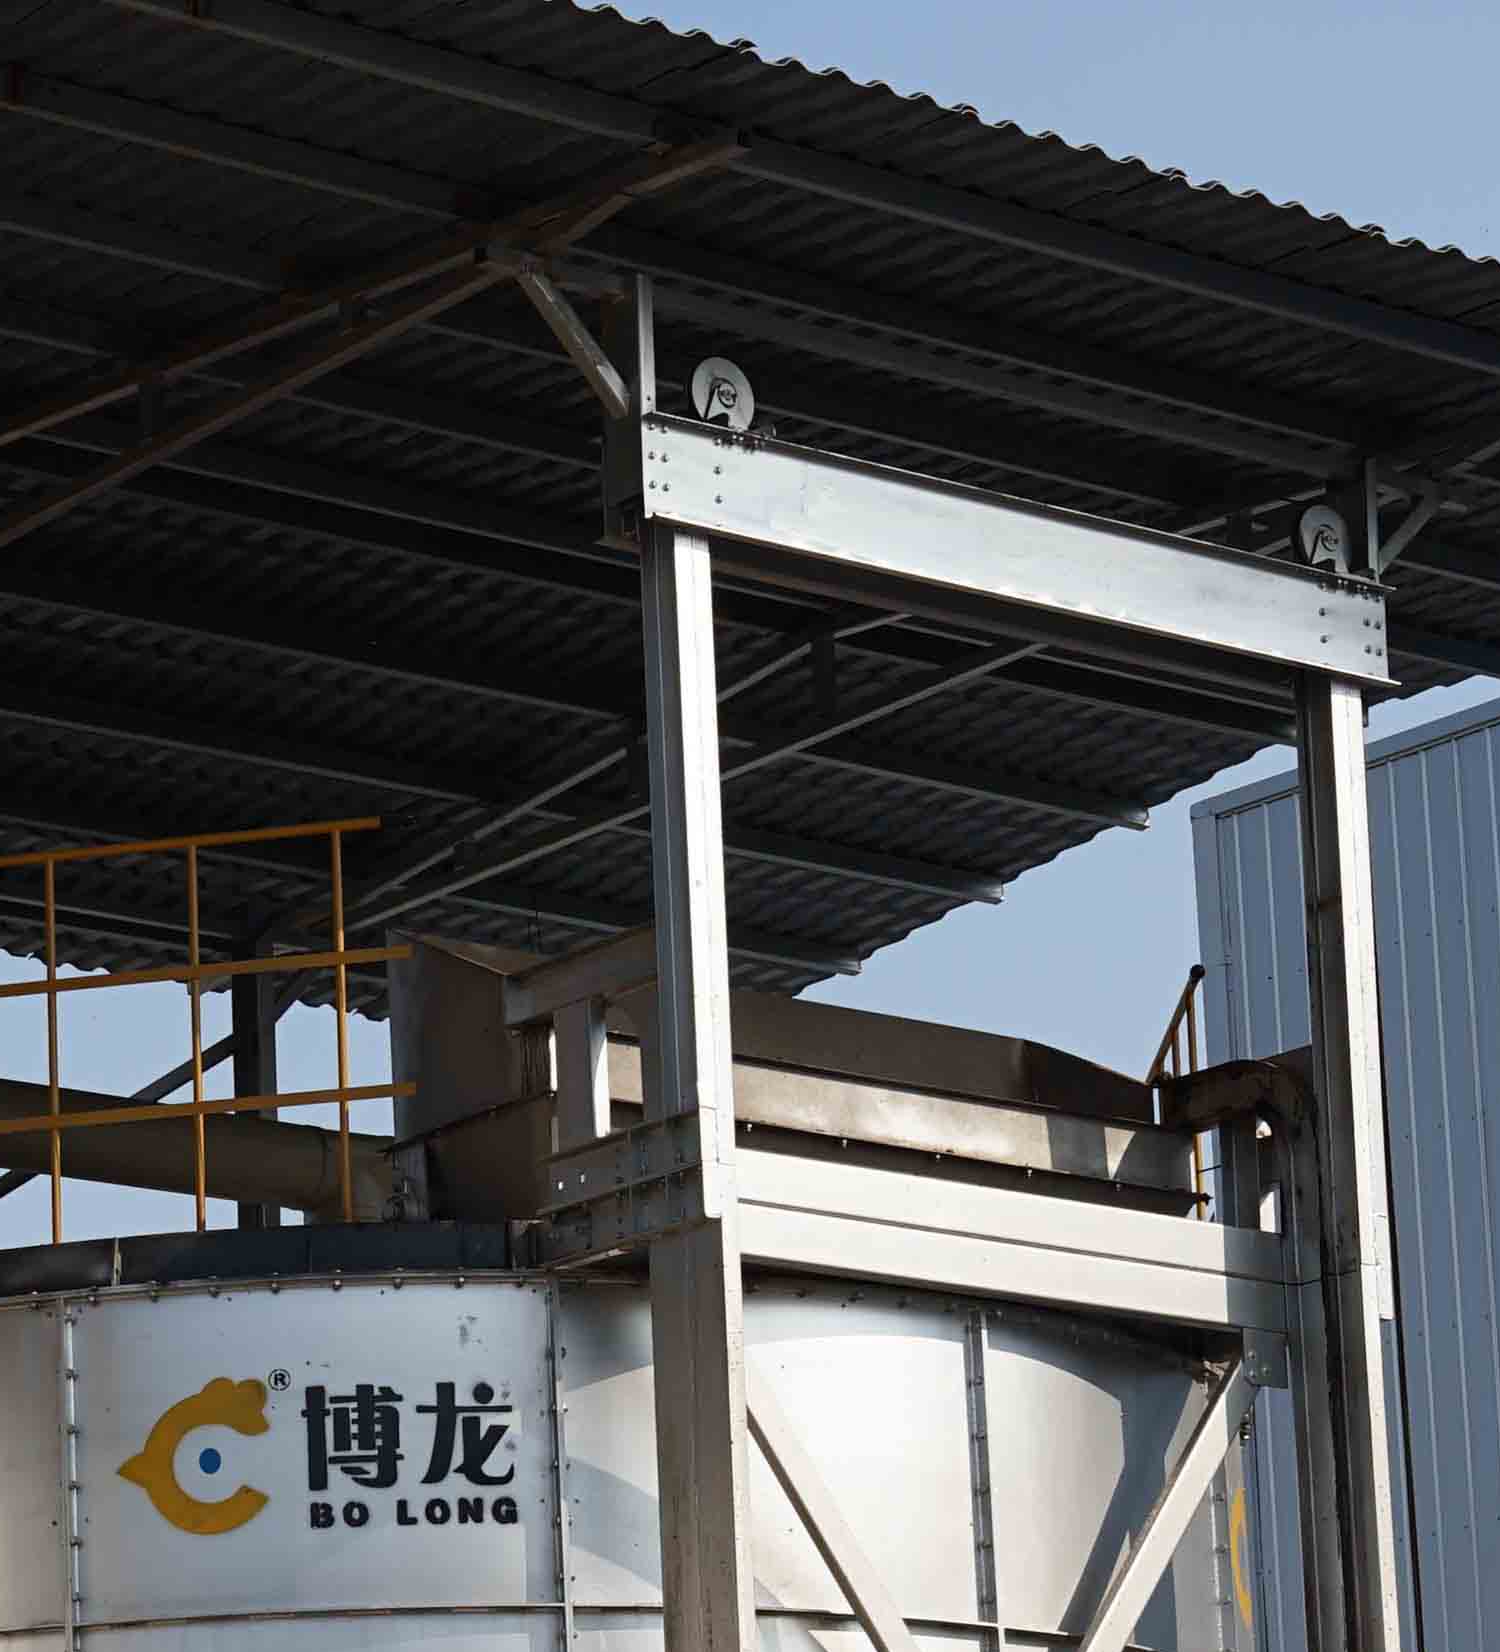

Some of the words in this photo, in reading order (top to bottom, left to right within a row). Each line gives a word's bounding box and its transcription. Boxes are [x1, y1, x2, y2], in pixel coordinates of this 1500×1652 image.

[301, 1382, 515, 1492] 博龙
[310, 1501, 370, 1529] BO
[396, 1497, 518, 1526] LONG
